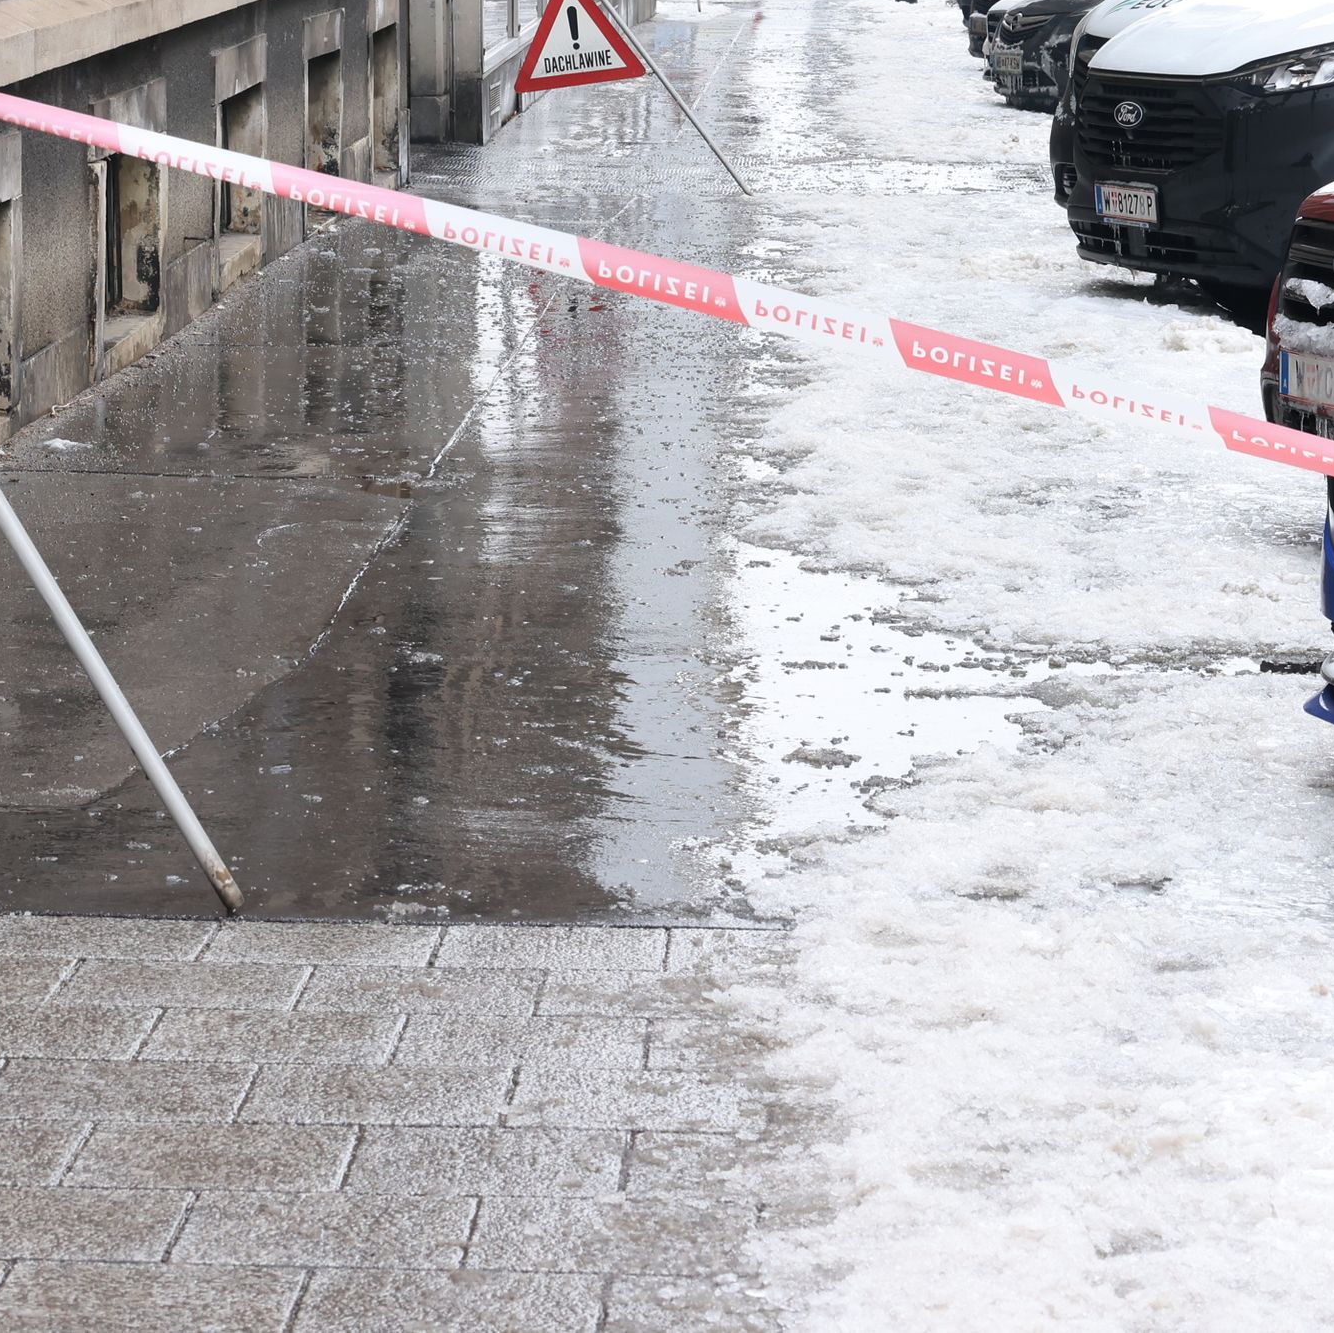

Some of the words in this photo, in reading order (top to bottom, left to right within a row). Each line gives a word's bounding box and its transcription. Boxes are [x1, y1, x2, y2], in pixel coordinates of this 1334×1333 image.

[544, 49, 612, 74] DACHLAWINE
[1117, 104, 1138, 123] Ford
[1103, 190, 1112, 212] W
